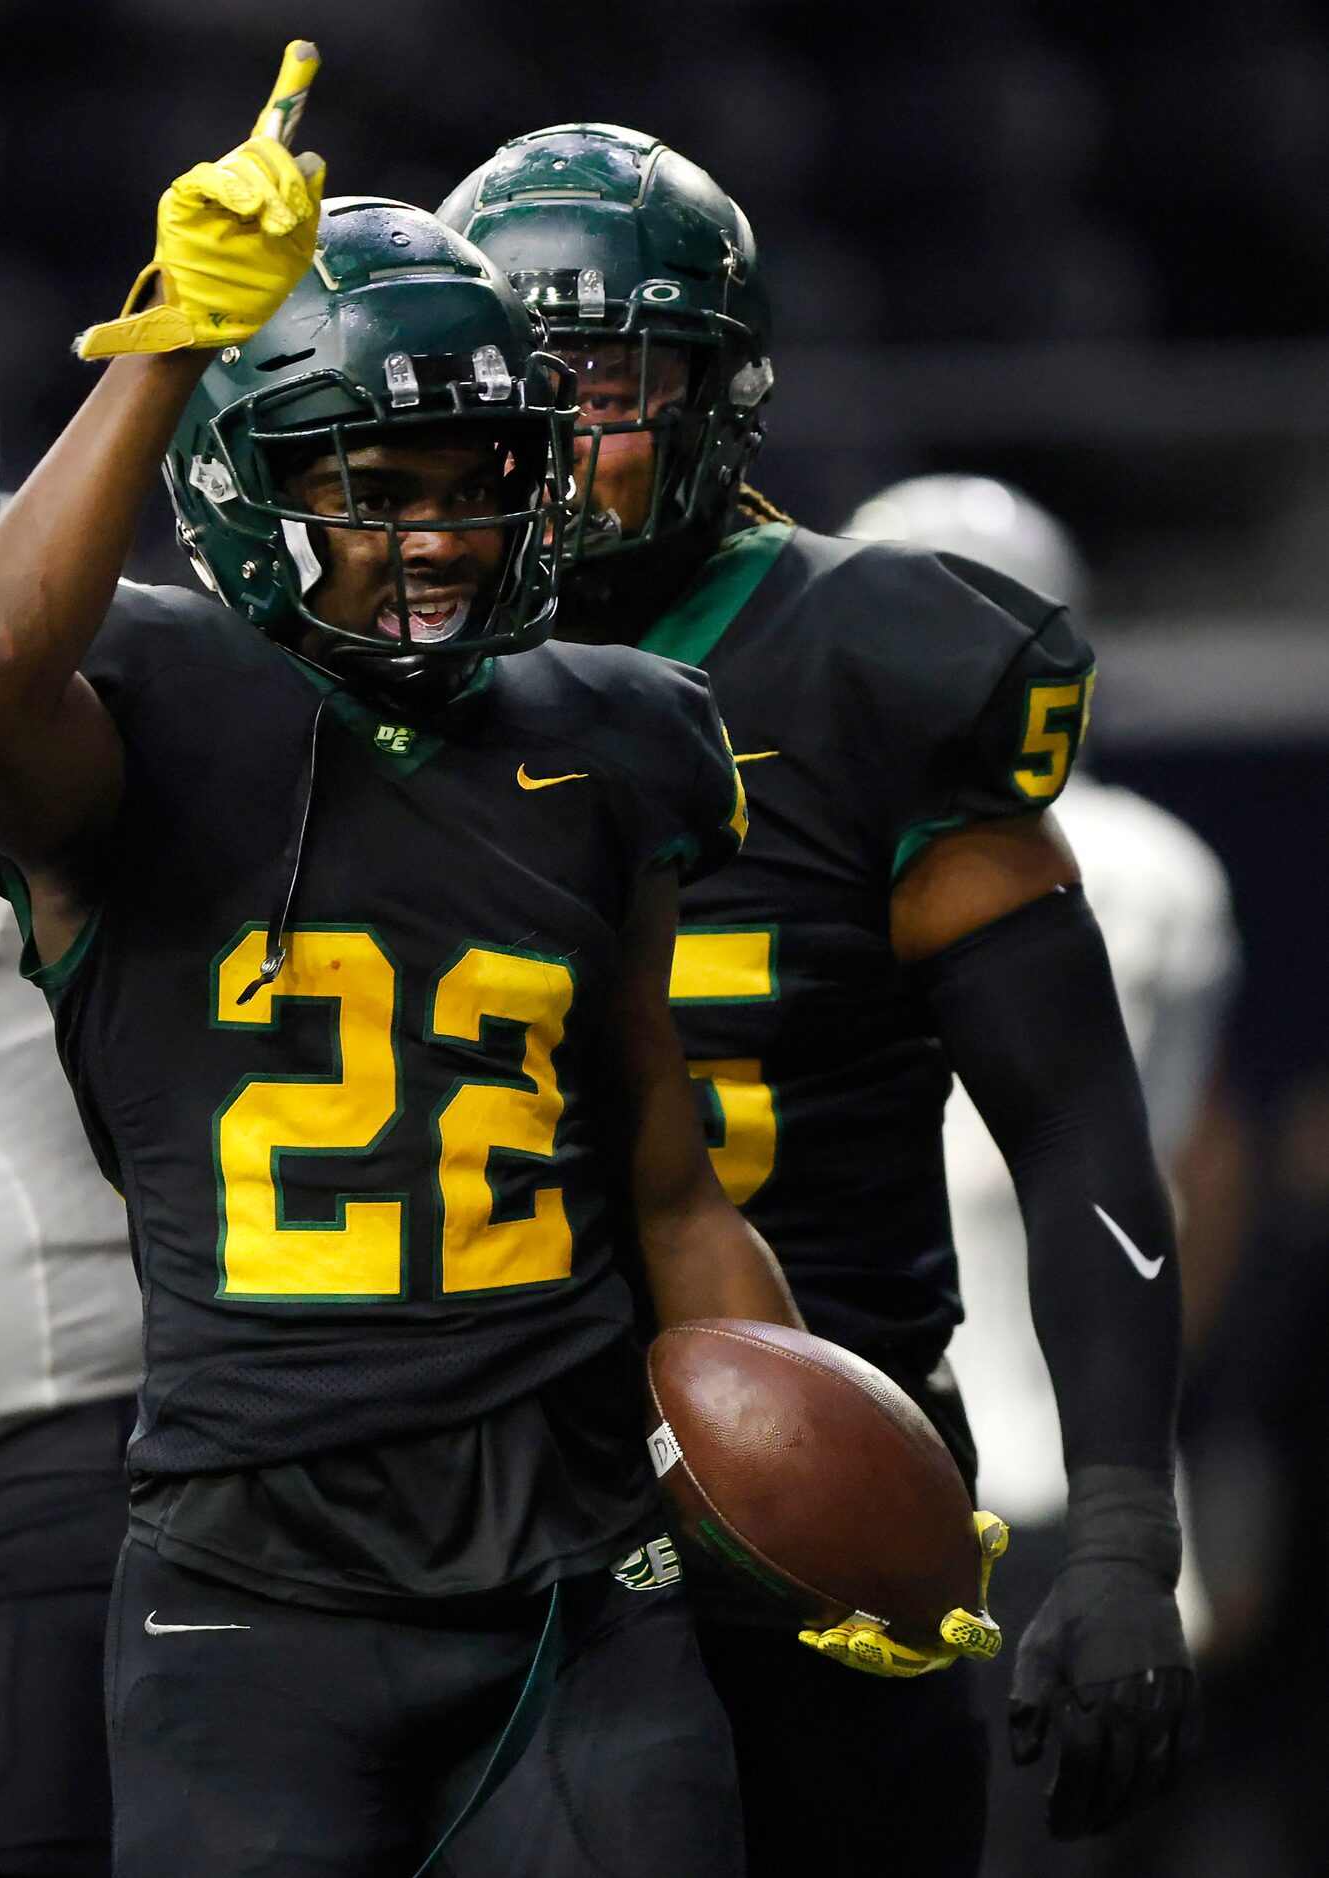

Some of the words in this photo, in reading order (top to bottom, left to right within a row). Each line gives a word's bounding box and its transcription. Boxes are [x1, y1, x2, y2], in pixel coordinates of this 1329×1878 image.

[376, 725, 411, 752] DE
[1010, 668, 1097, 799] 5
[210, 921, 575, 1304] 22
